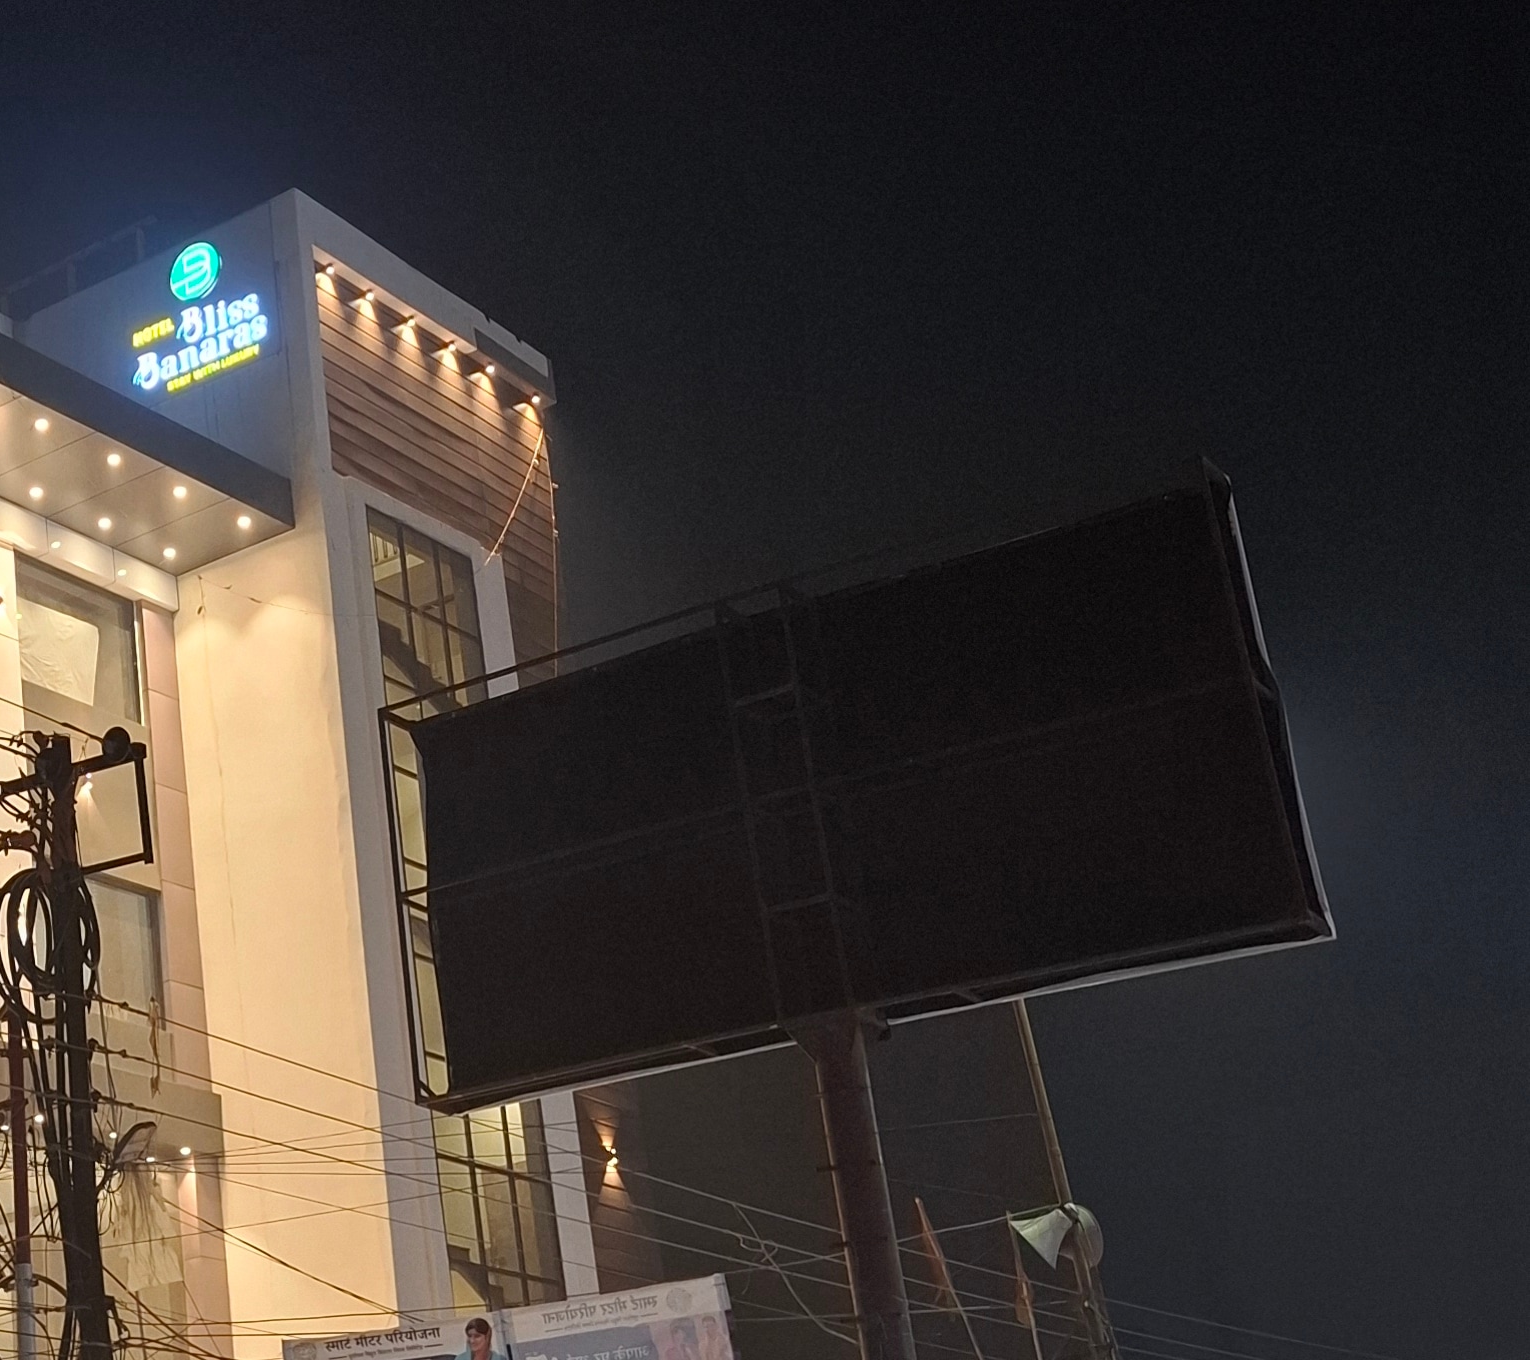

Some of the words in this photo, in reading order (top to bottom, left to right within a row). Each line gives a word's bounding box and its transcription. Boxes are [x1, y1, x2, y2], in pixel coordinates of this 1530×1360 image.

[132, 318, 175, 348] HOTEL
[176, 293, 259, 344] Bliss
[132, 314, 268, 390] Banaras
[355, 1333, 382, 1349] मीटर
[385, 1327, 441, 1345] परियोजना
